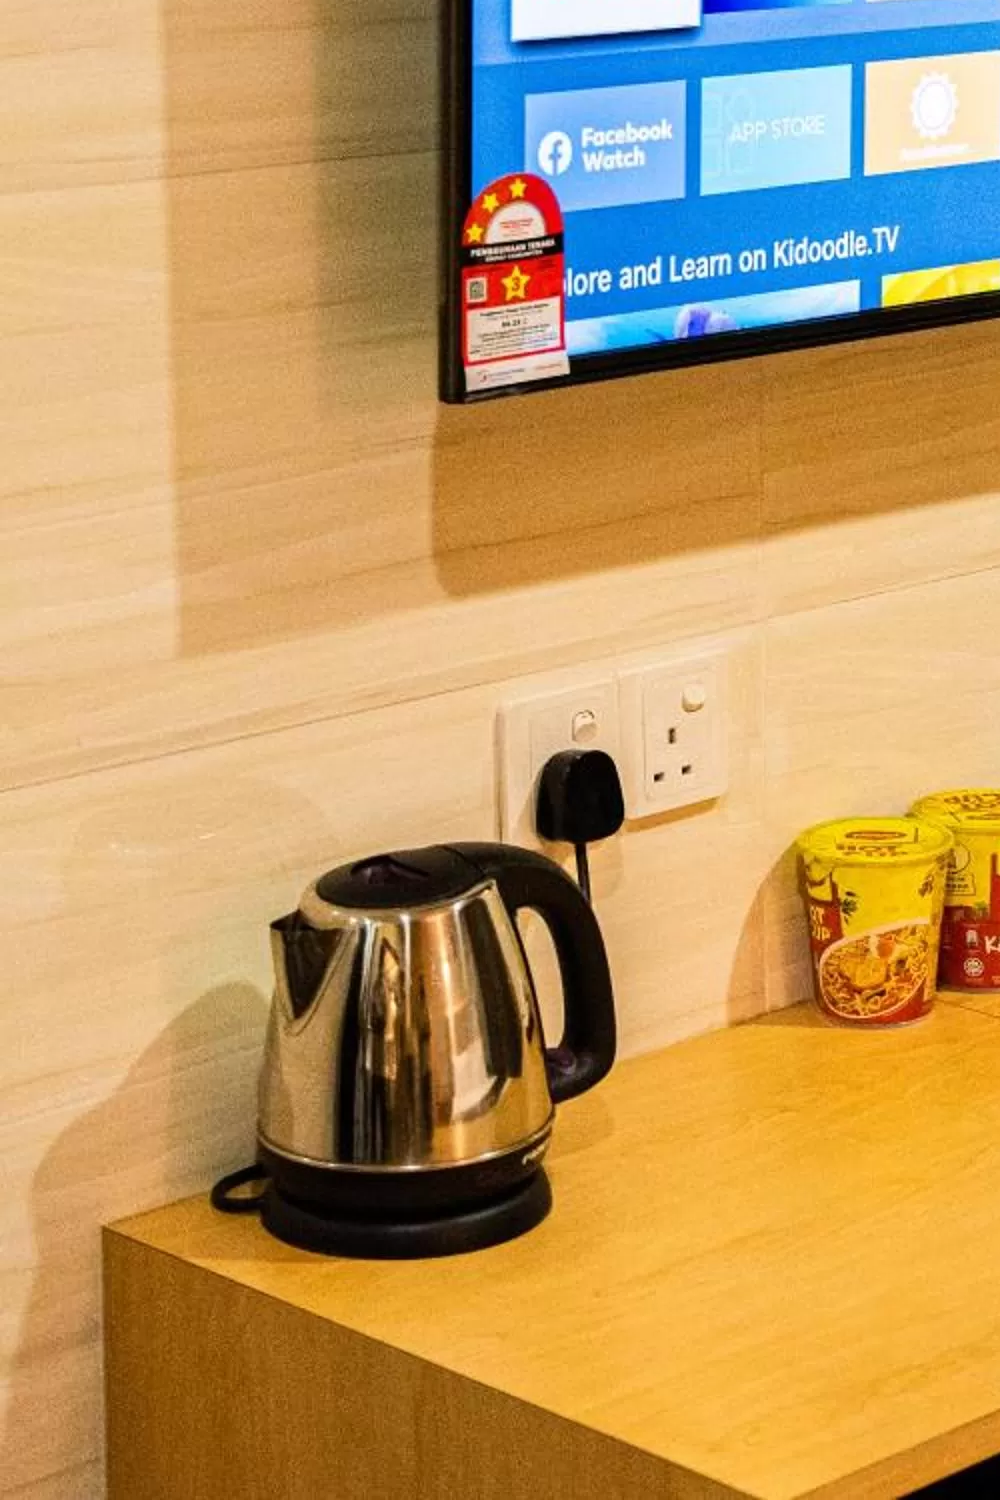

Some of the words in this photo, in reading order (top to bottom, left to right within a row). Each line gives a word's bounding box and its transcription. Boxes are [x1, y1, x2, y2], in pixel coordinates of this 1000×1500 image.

[581, 119, 673, 148] Facebook
[730, 120, 767, 143] APP
[771, 115, 825, 140] STORE
[582, 147, 646, 172] Watch
[563, 267, 612, 297] lore
[619, 257, 661, 290] and
[669, 253, 732, 283] Learn
[739, 249, 767, 274] on
[773, 225, 900, 268] Kidoodle.TV
[511, 277, 520, 293] 3
